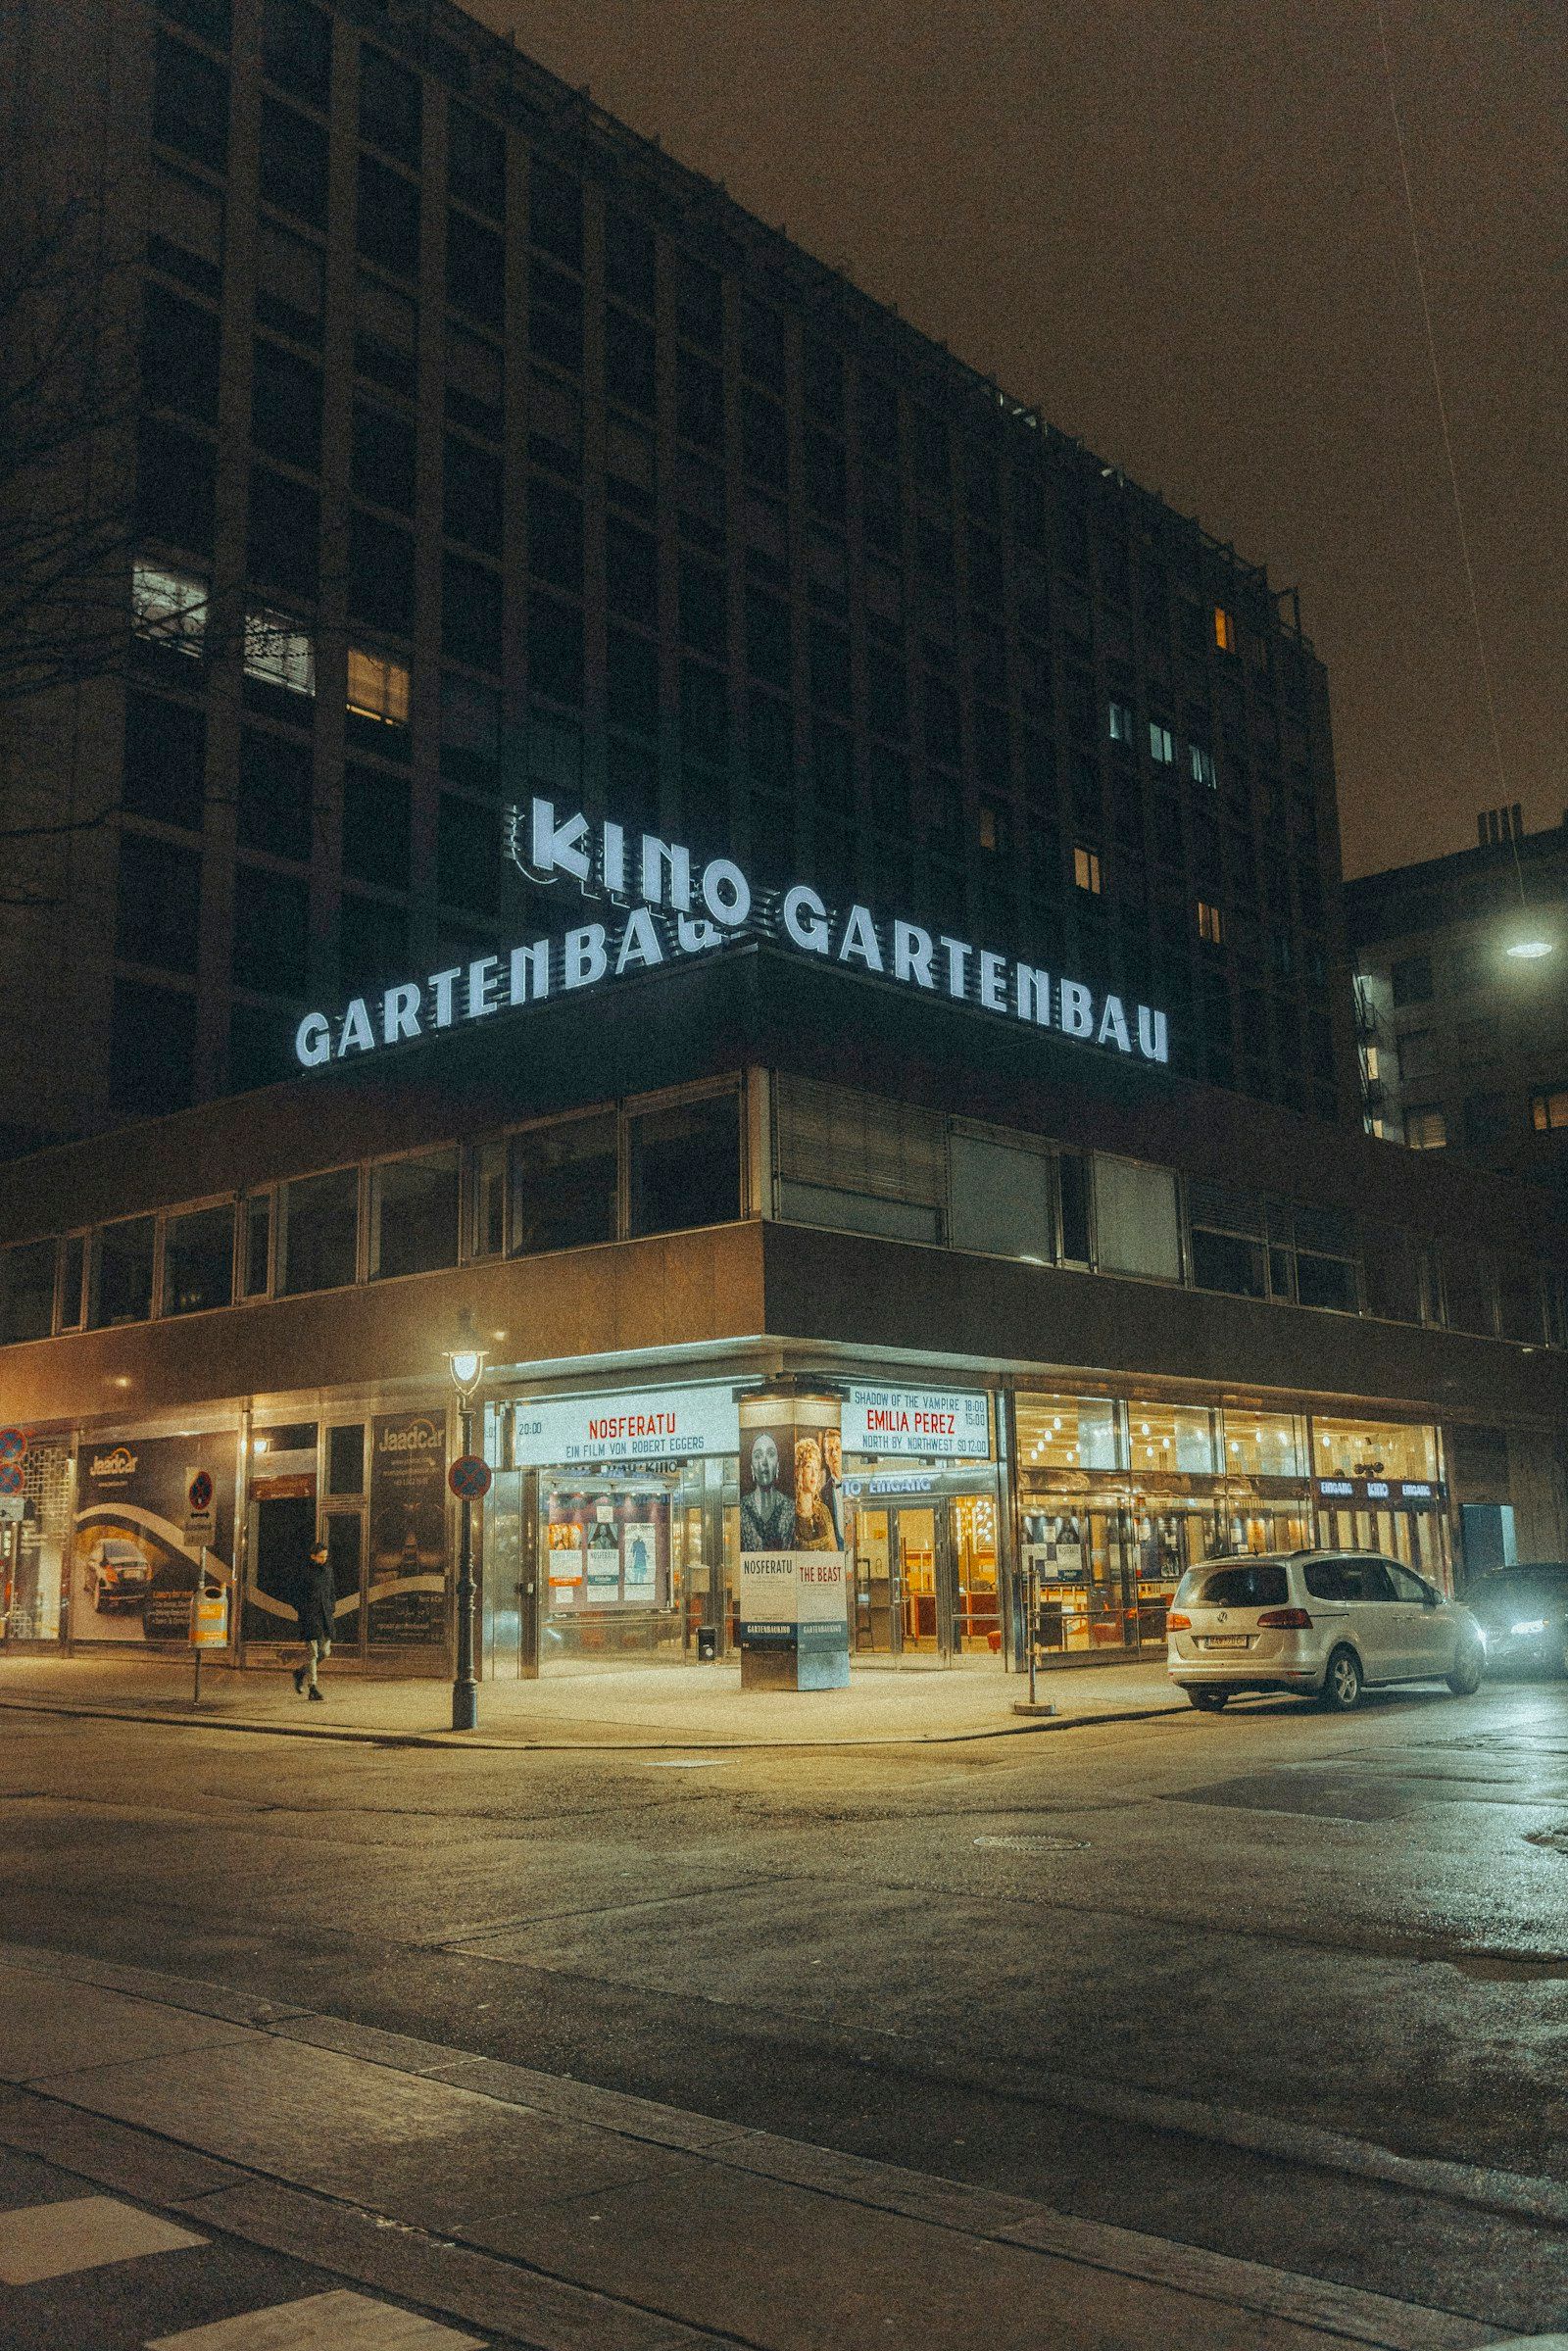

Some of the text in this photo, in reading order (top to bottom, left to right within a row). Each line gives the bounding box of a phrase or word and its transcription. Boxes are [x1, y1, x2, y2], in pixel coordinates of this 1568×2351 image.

[532, 797, 752, 926] KINO
[783, 885, 1169, 1064] GARTENBAU
[294, 906, 722, 1067] GARTENBAU
[855, 1391, 985, 1413] SHADOW OF THE VAMPIRE 18:00
[518, 1422, 542, 1436] 20:00
[589, 1412, 676, 1440] NOSFERATU
[867, 1409, 909, 1433] EMILIA
[914, 1412, 956, 1435] PEREZ
[378, 1426, 446, 1452] Jaadcar
[566, 1436, 705, 1458] EIN FILM VON ROBERT EGGERS
[862, 1435, 889, 1448] NORTH
[892, 1436, 903, 1448] BY
[907, 1437, 954, 1452] NORTHWEST
[868, 1477, 931, 1494] EINGANG
[744, 1559, 793, 1575] NOSFERATU
[800, 1567, 842, 1583] THE BEAST
